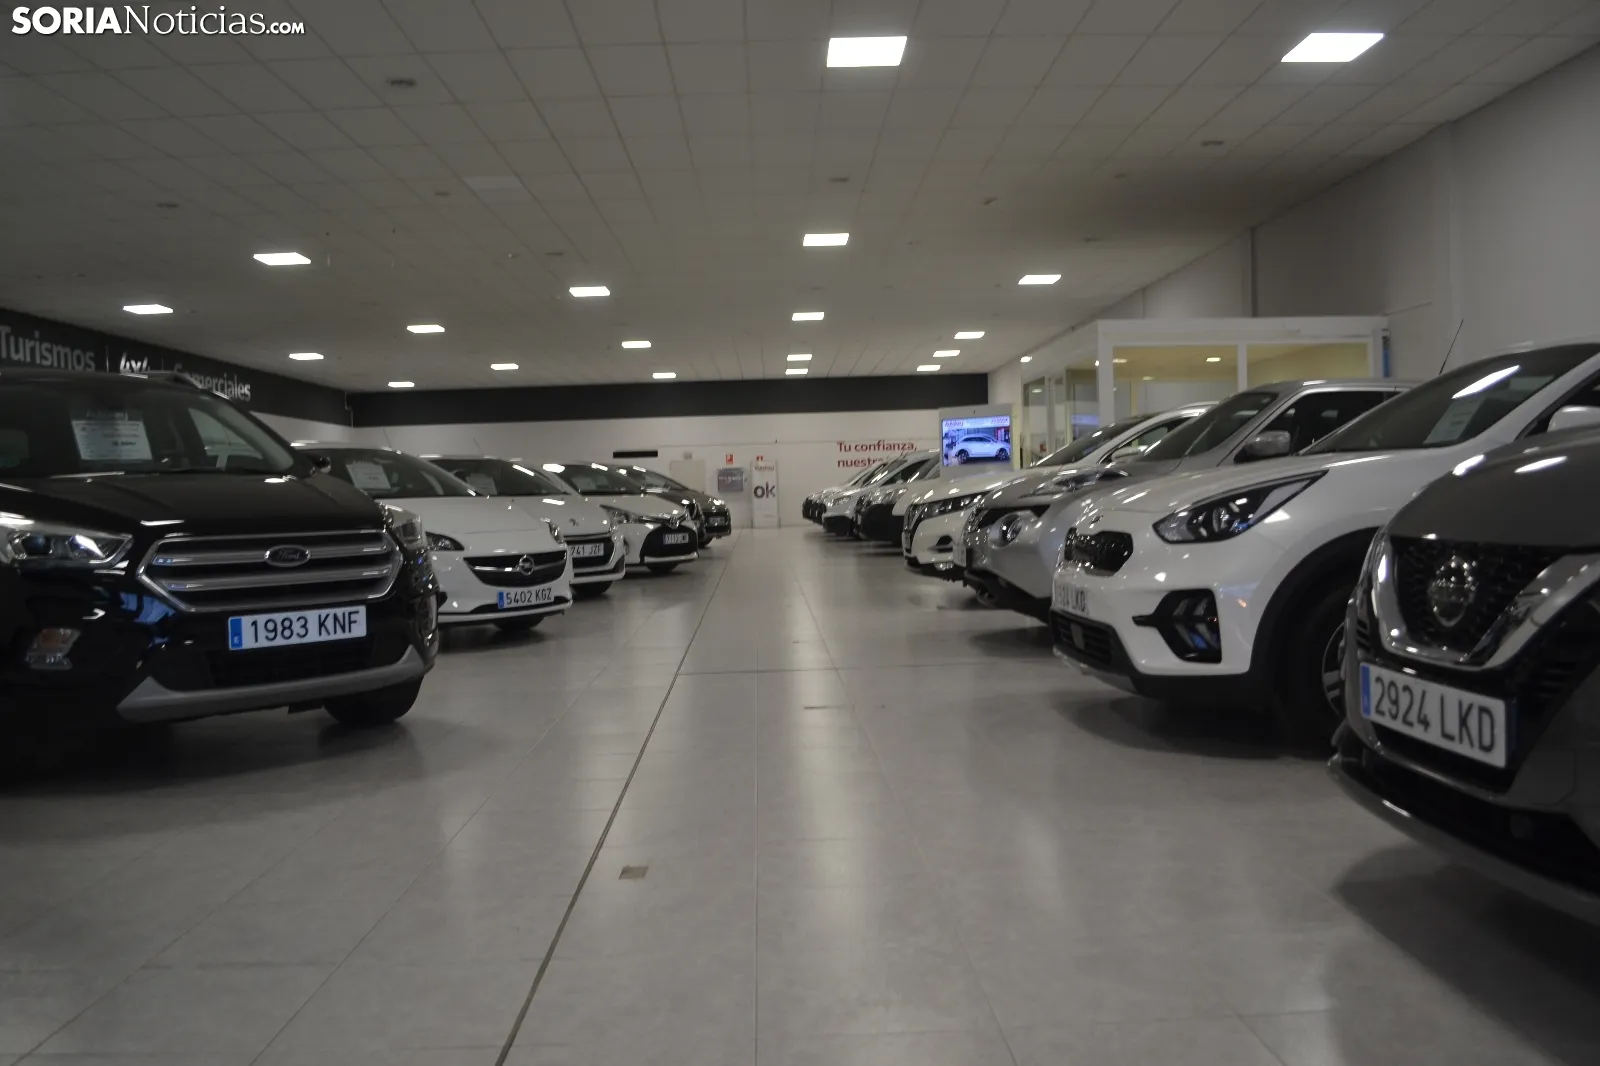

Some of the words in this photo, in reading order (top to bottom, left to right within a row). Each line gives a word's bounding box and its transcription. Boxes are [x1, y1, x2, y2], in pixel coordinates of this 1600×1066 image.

[0, 325, 96, 372] Turismos
[837, 440, 852, 452] Tu
[753, 482, 776, 499] ok
[506, 590, 533, 605] 5402
[535, 586, 553, 602] KGZ
[250, 616, 309, 643] 1983
[318, 610, 360, 637] KNF
[1374, 676, 1430, 732] 2924
[1440, 694, 1495, 753] LKD
